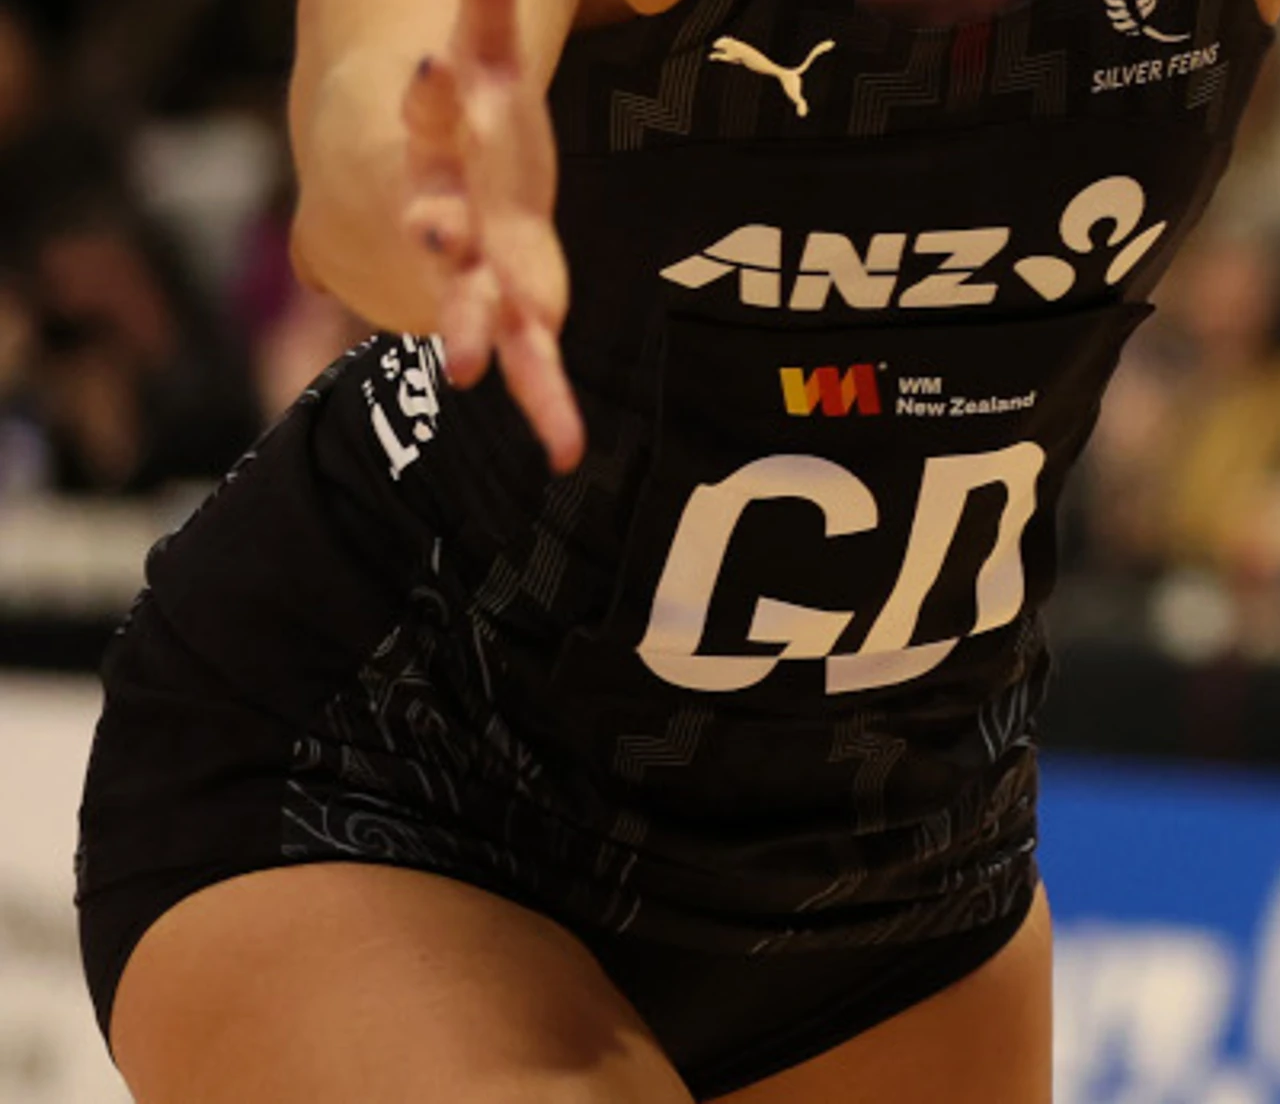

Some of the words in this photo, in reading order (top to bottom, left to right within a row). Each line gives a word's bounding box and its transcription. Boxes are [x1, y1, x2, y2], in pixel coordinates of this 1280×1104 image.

[1091, 59, 1163, 94] SILVER
[659, 223, 1010, 311] ANZ
[896, 398, 946, 417] New
[949, 390, 1038, 417] Zealand
[898, 377, 942, 395] WM
[635, 441, 1047, 695] GD
